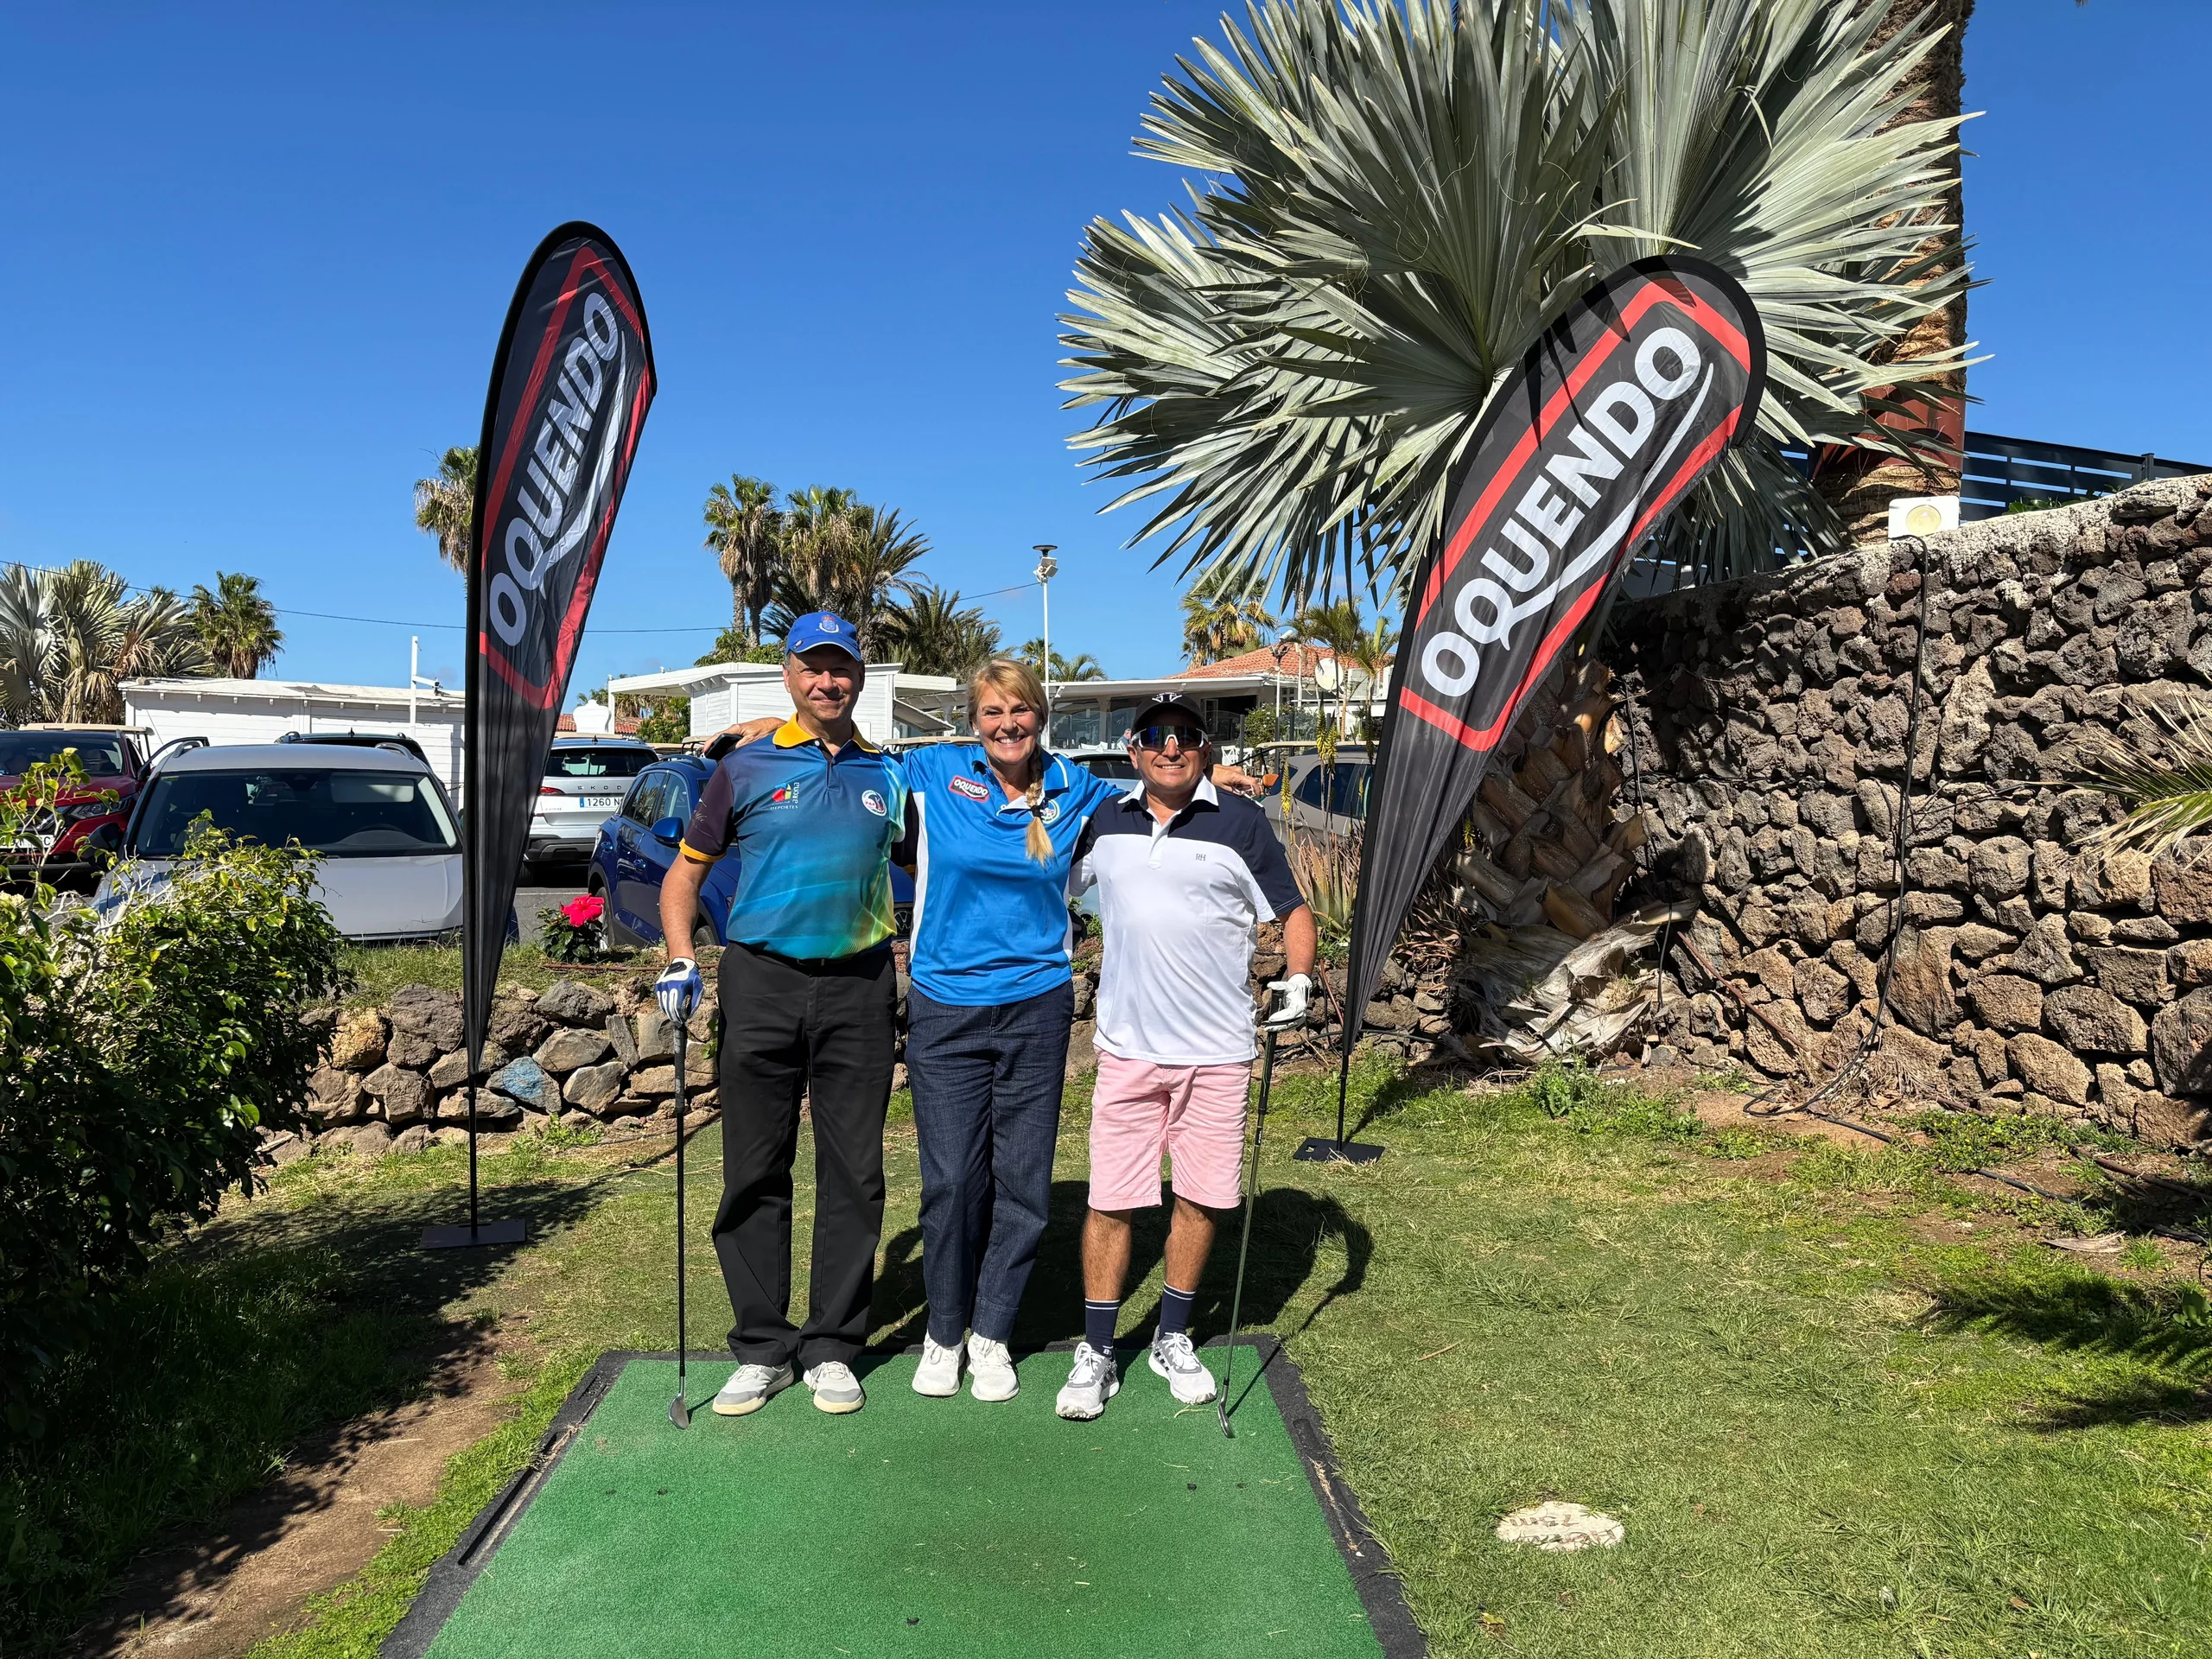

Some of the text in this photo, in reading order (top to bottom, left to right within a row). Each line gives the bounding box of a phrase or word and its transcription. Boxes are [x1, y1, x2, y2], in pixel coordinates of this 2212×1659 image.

[489, 292, 620, 647] OQUENDO
[1421, 327, 1702, 697] OQUENDO
[588, 798, 611, 807] 1260
[954, 779, 988, 797] OQUENDO
